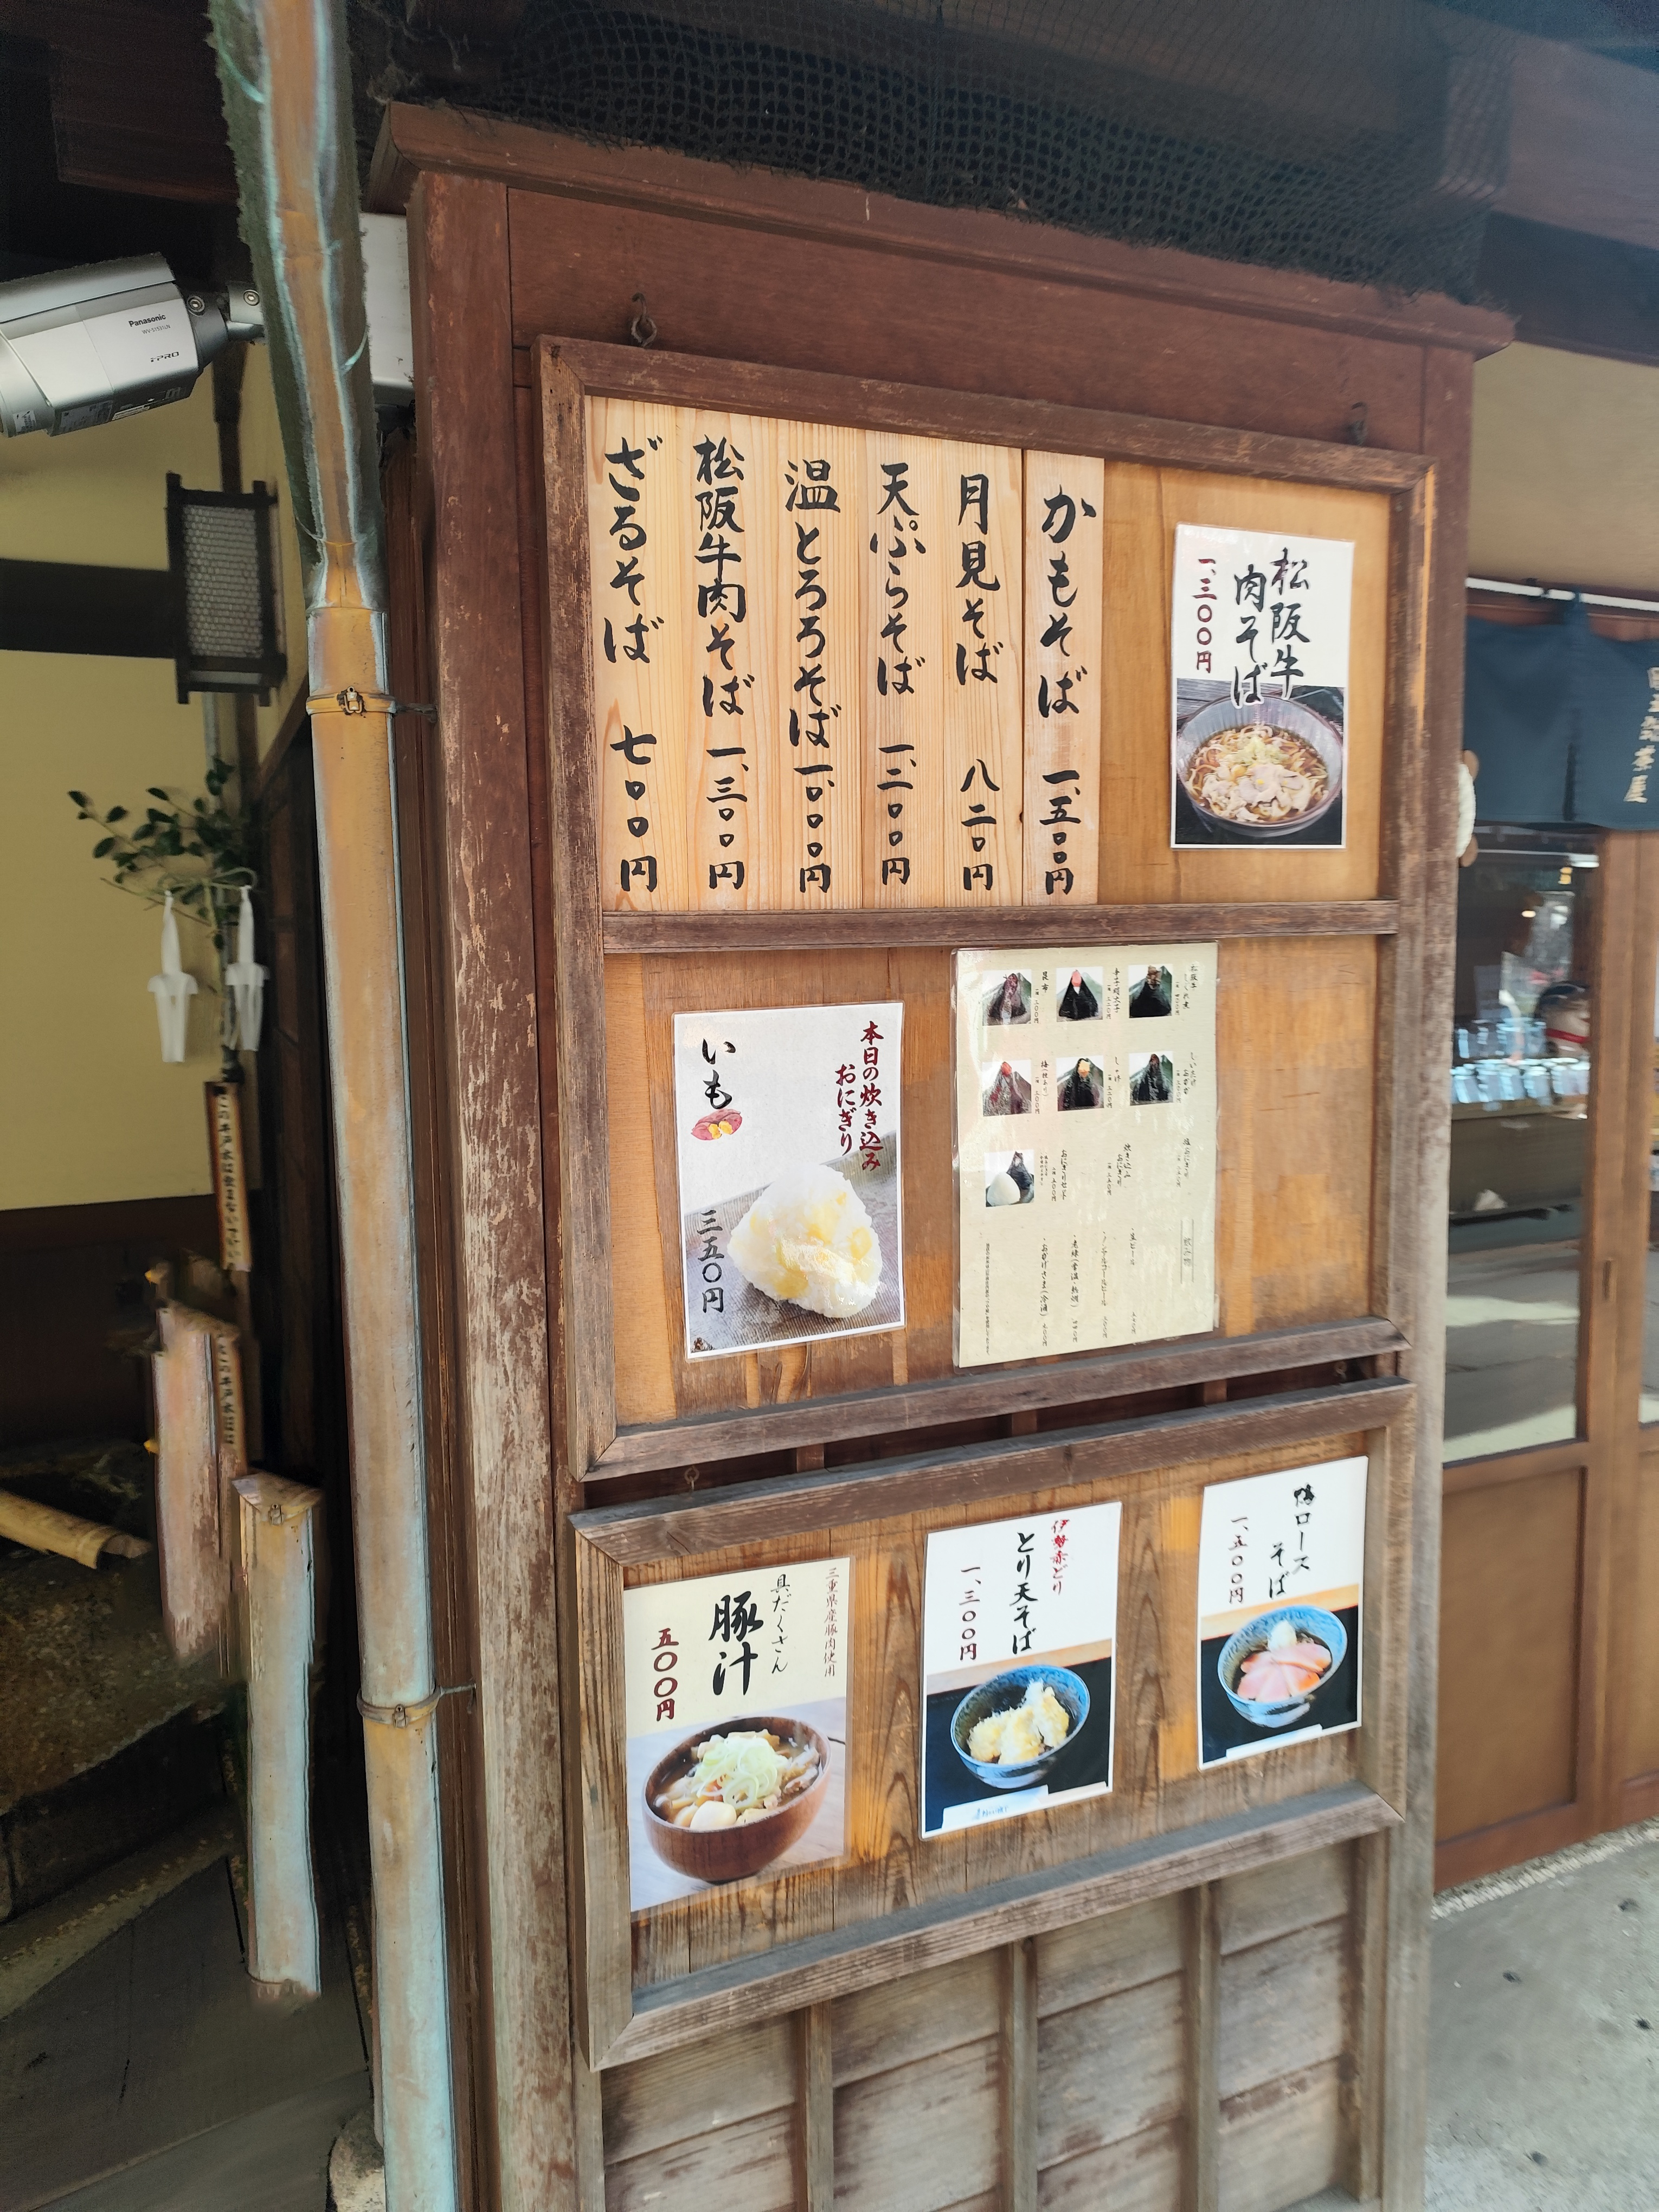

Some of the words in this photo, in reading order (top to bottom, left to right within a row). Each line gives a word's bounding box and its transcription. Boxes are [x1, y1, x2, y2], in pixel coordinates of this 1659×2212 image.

[128, 314, 166, 327] Panasonic
[603, 435, 664, 664] ざるそば
[692, 434, 755, 718] 松阪牛肉そば
[784, 459, 842, 749] 温とろろそば
[870, 462, 927, 697] 天ぷらそば
[955, 473, 1004, 686] 月見そば
[1038, 484, 1097, 718] かもそば
[1230, 564, 1268, 709] 肉そば
[1270, 547, 1311, 700] 松阪牛
[702, 1038, 736, 1112] いも
[835, 1063, 857, 1156] おにぎり
[860, 1020, 885, 1172] 本日の炊き込み
[696, 1210, 725, 1314] 三五〇円
[770, 1574, 790, 1674] 具だくさん
[824, 1567, 839, 1677] 三重県産豚肉使用
[1009, 1532, 1038, 1655] とり天そば
[1269, 1542, 1289, 1599] そば
[651, 1628, 679, 1722] 五〇〇円
[708, 1591, 764, 1696] 豚汁
